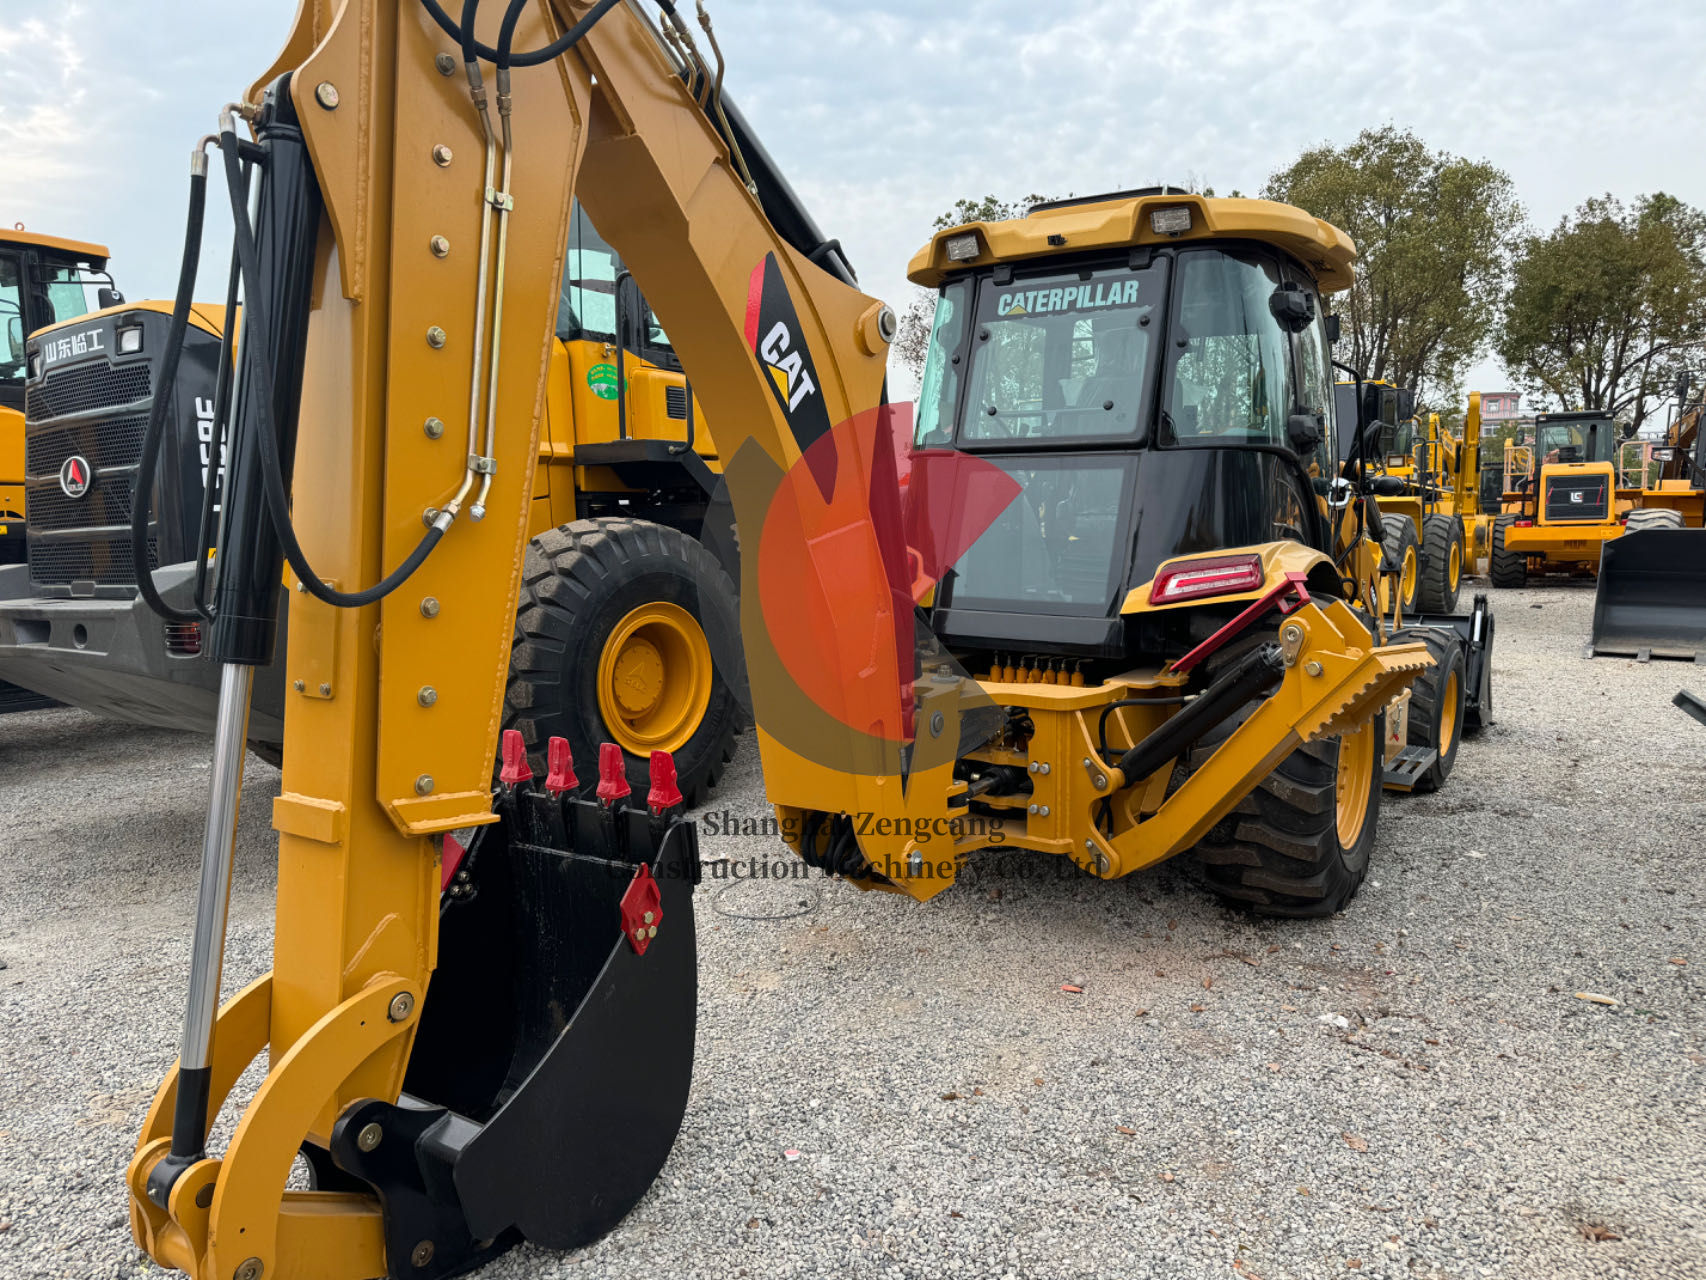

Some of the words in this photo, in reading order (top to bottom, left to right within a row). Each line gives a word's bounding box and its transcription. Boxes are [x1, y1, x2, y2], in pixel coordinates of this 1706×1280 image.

[998, 280, 1139, 316] CATERPILLAR
[45, 328, 105, 363] 山东临工
[761, 321, 816, 413] CAT
